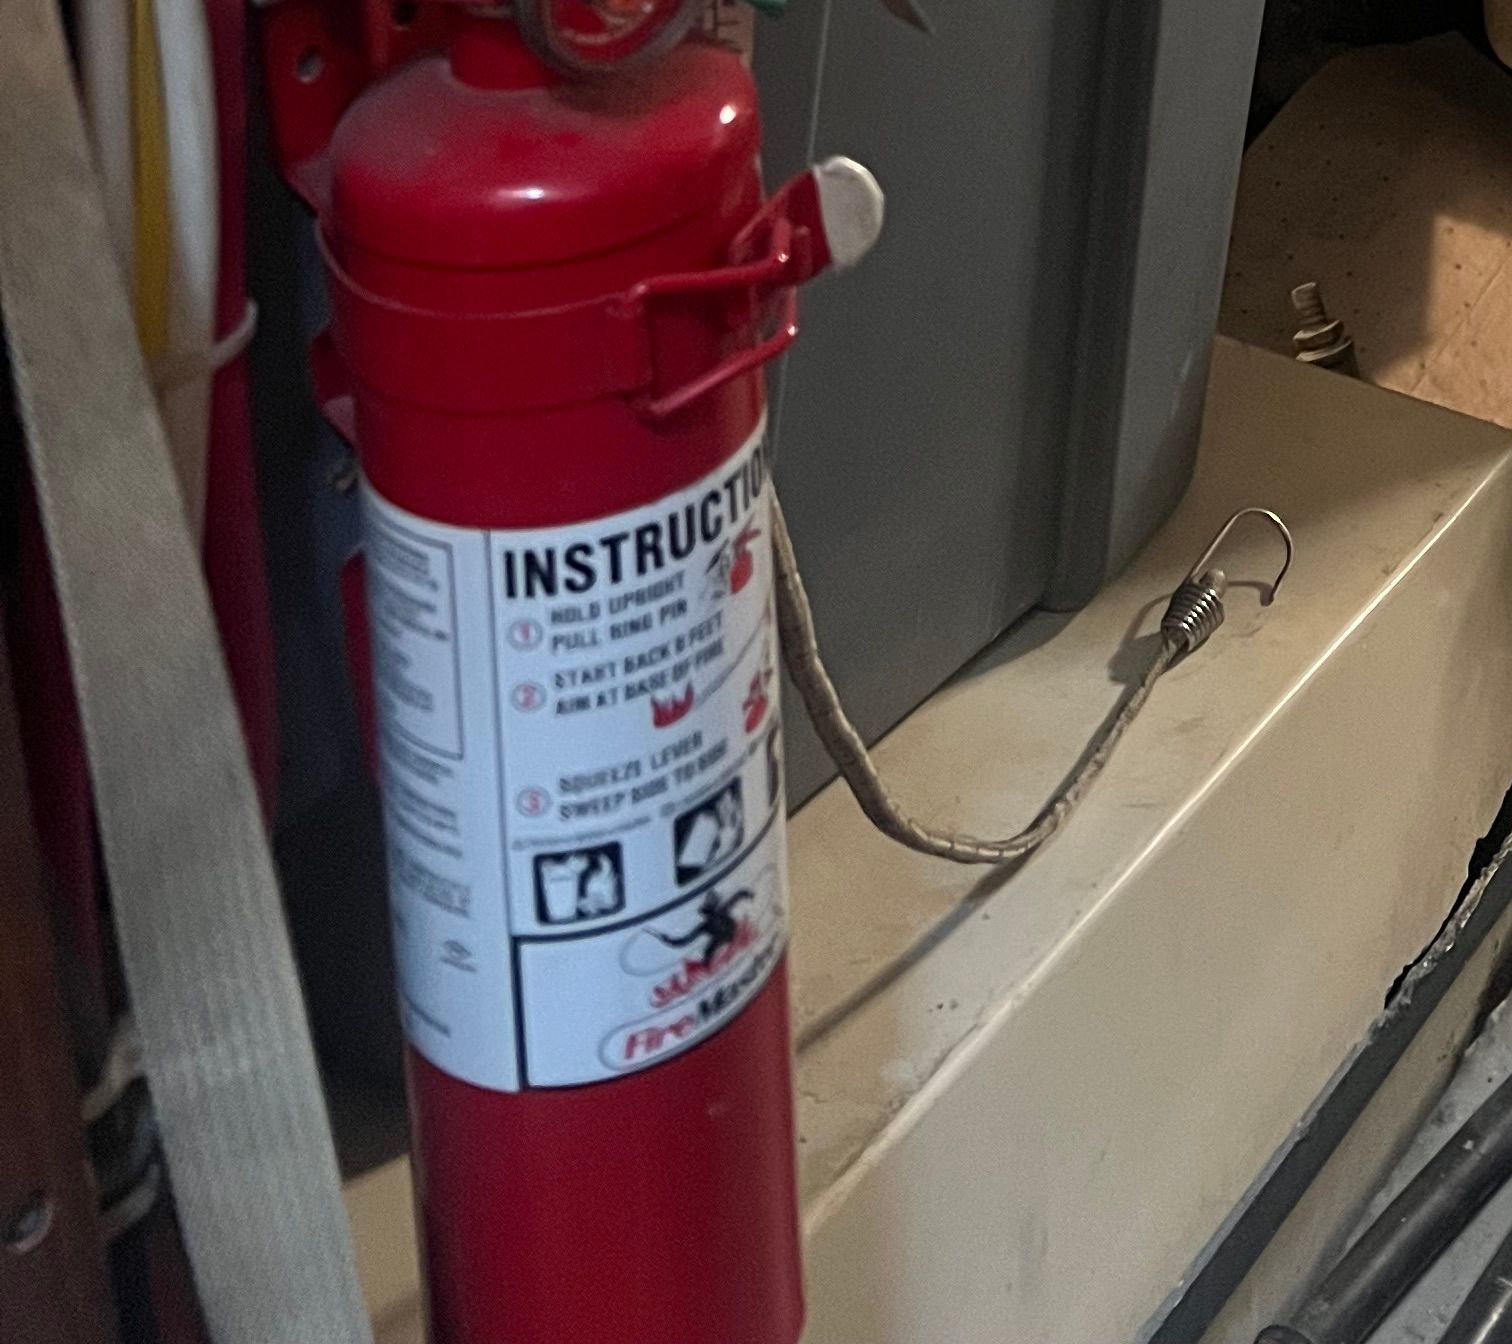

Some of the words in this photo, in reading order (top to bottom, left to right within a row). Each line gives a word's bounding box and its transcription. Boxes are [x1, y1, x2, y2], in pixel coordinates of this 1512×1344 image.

[551, 601, 600, 624] HOLD
[609, 570, 685, 615] UPRIGHT
[553, 628, 598, 653] PULL
[610, 612, 653, 641] RING
[660, 598, 688, 625] PIN
[555, 661, 616, 689] START
[624, 642, 671, 675] BACK
[689, 609, 722, 649] FEET
[556, 695, 591, 715] AIM
[597, 686, 618, 708] AT
[624, 670, 667, 701] BASE
[672, 657, 691, 683] OF
[651, 730, 702, 770] LEVER
[559, 792, 626, 821] SWEEP
